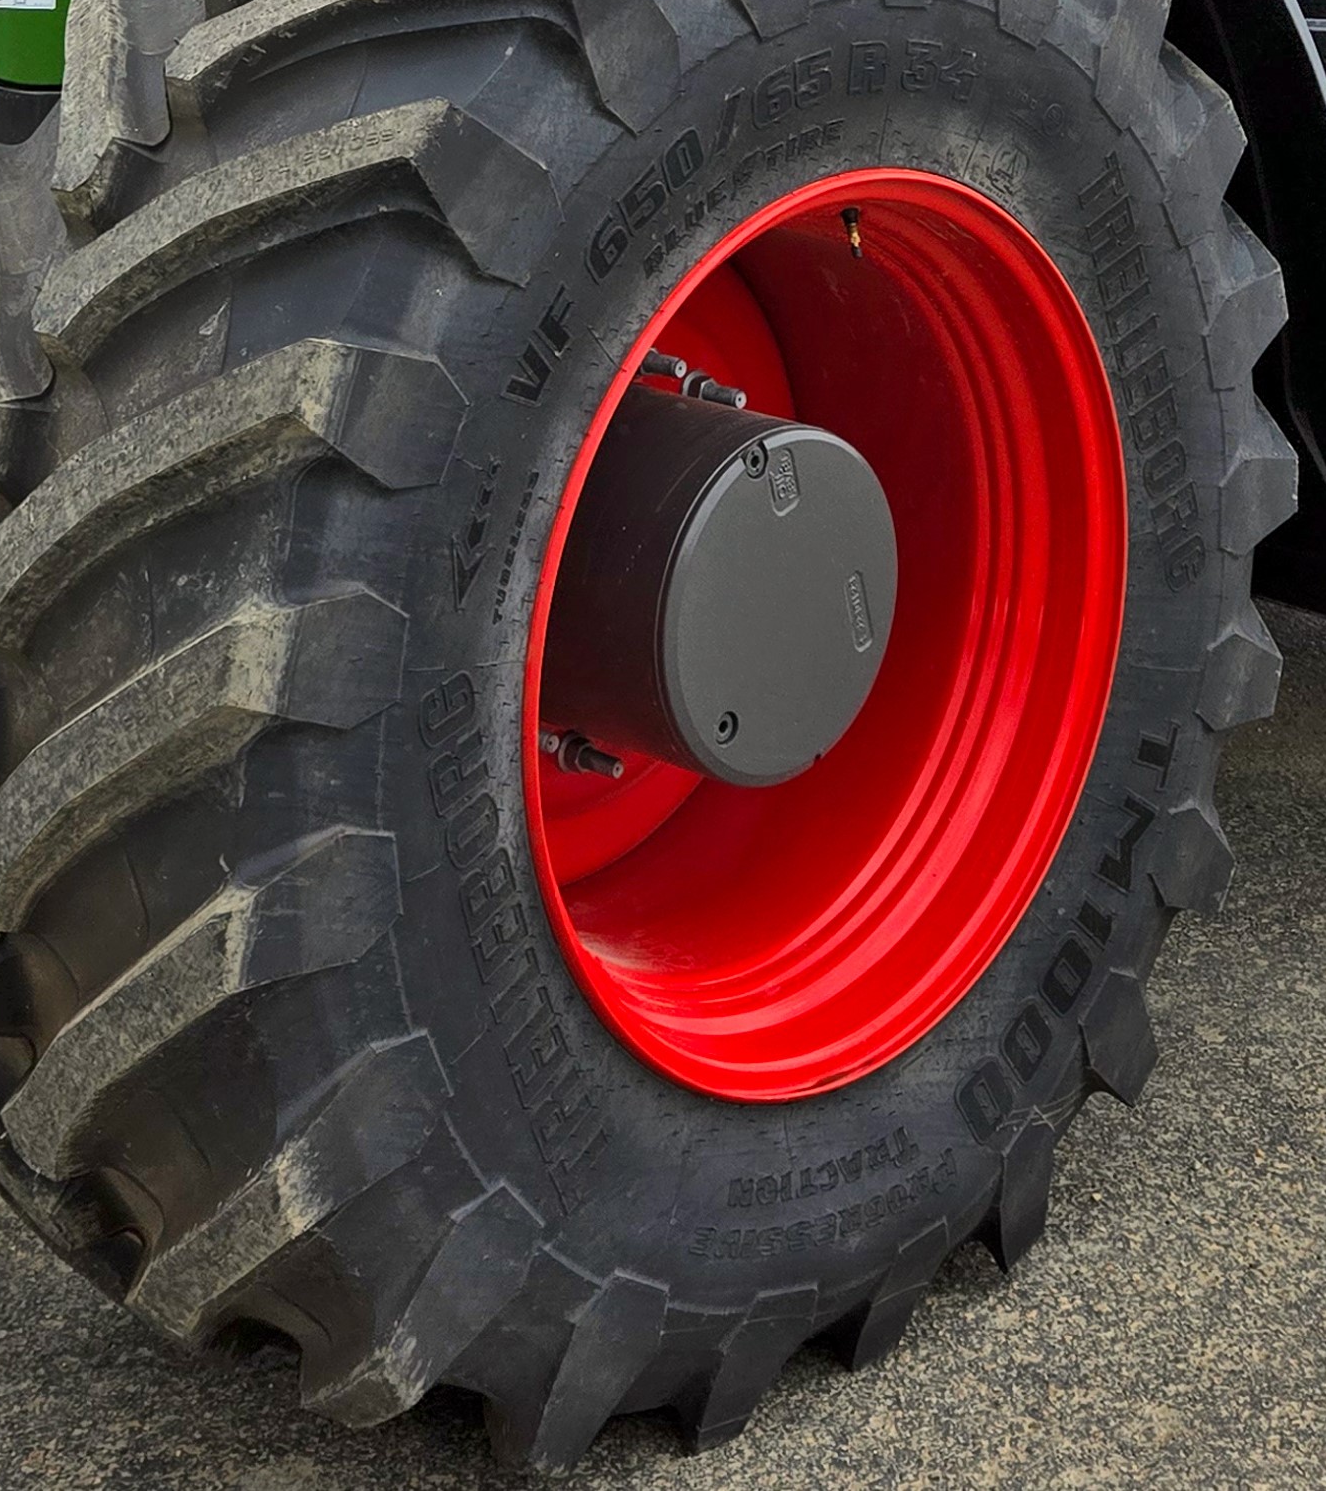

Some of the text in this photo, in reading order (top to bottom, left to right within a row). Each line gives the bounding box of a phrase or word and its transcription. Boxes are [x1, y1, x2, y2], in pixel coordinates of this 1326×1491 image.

[501, 282, 576, 408] VF
[1077, 150, 1206, 594] TRELLEBORG
[417, 669, 611, 1219] TRELLEBORG
[953, 718, 1182, 1147] TM1000
[688, 1147, 959, 1261] PROGRESSIVE
[726, 1125, 922, 1209] TRACTION
